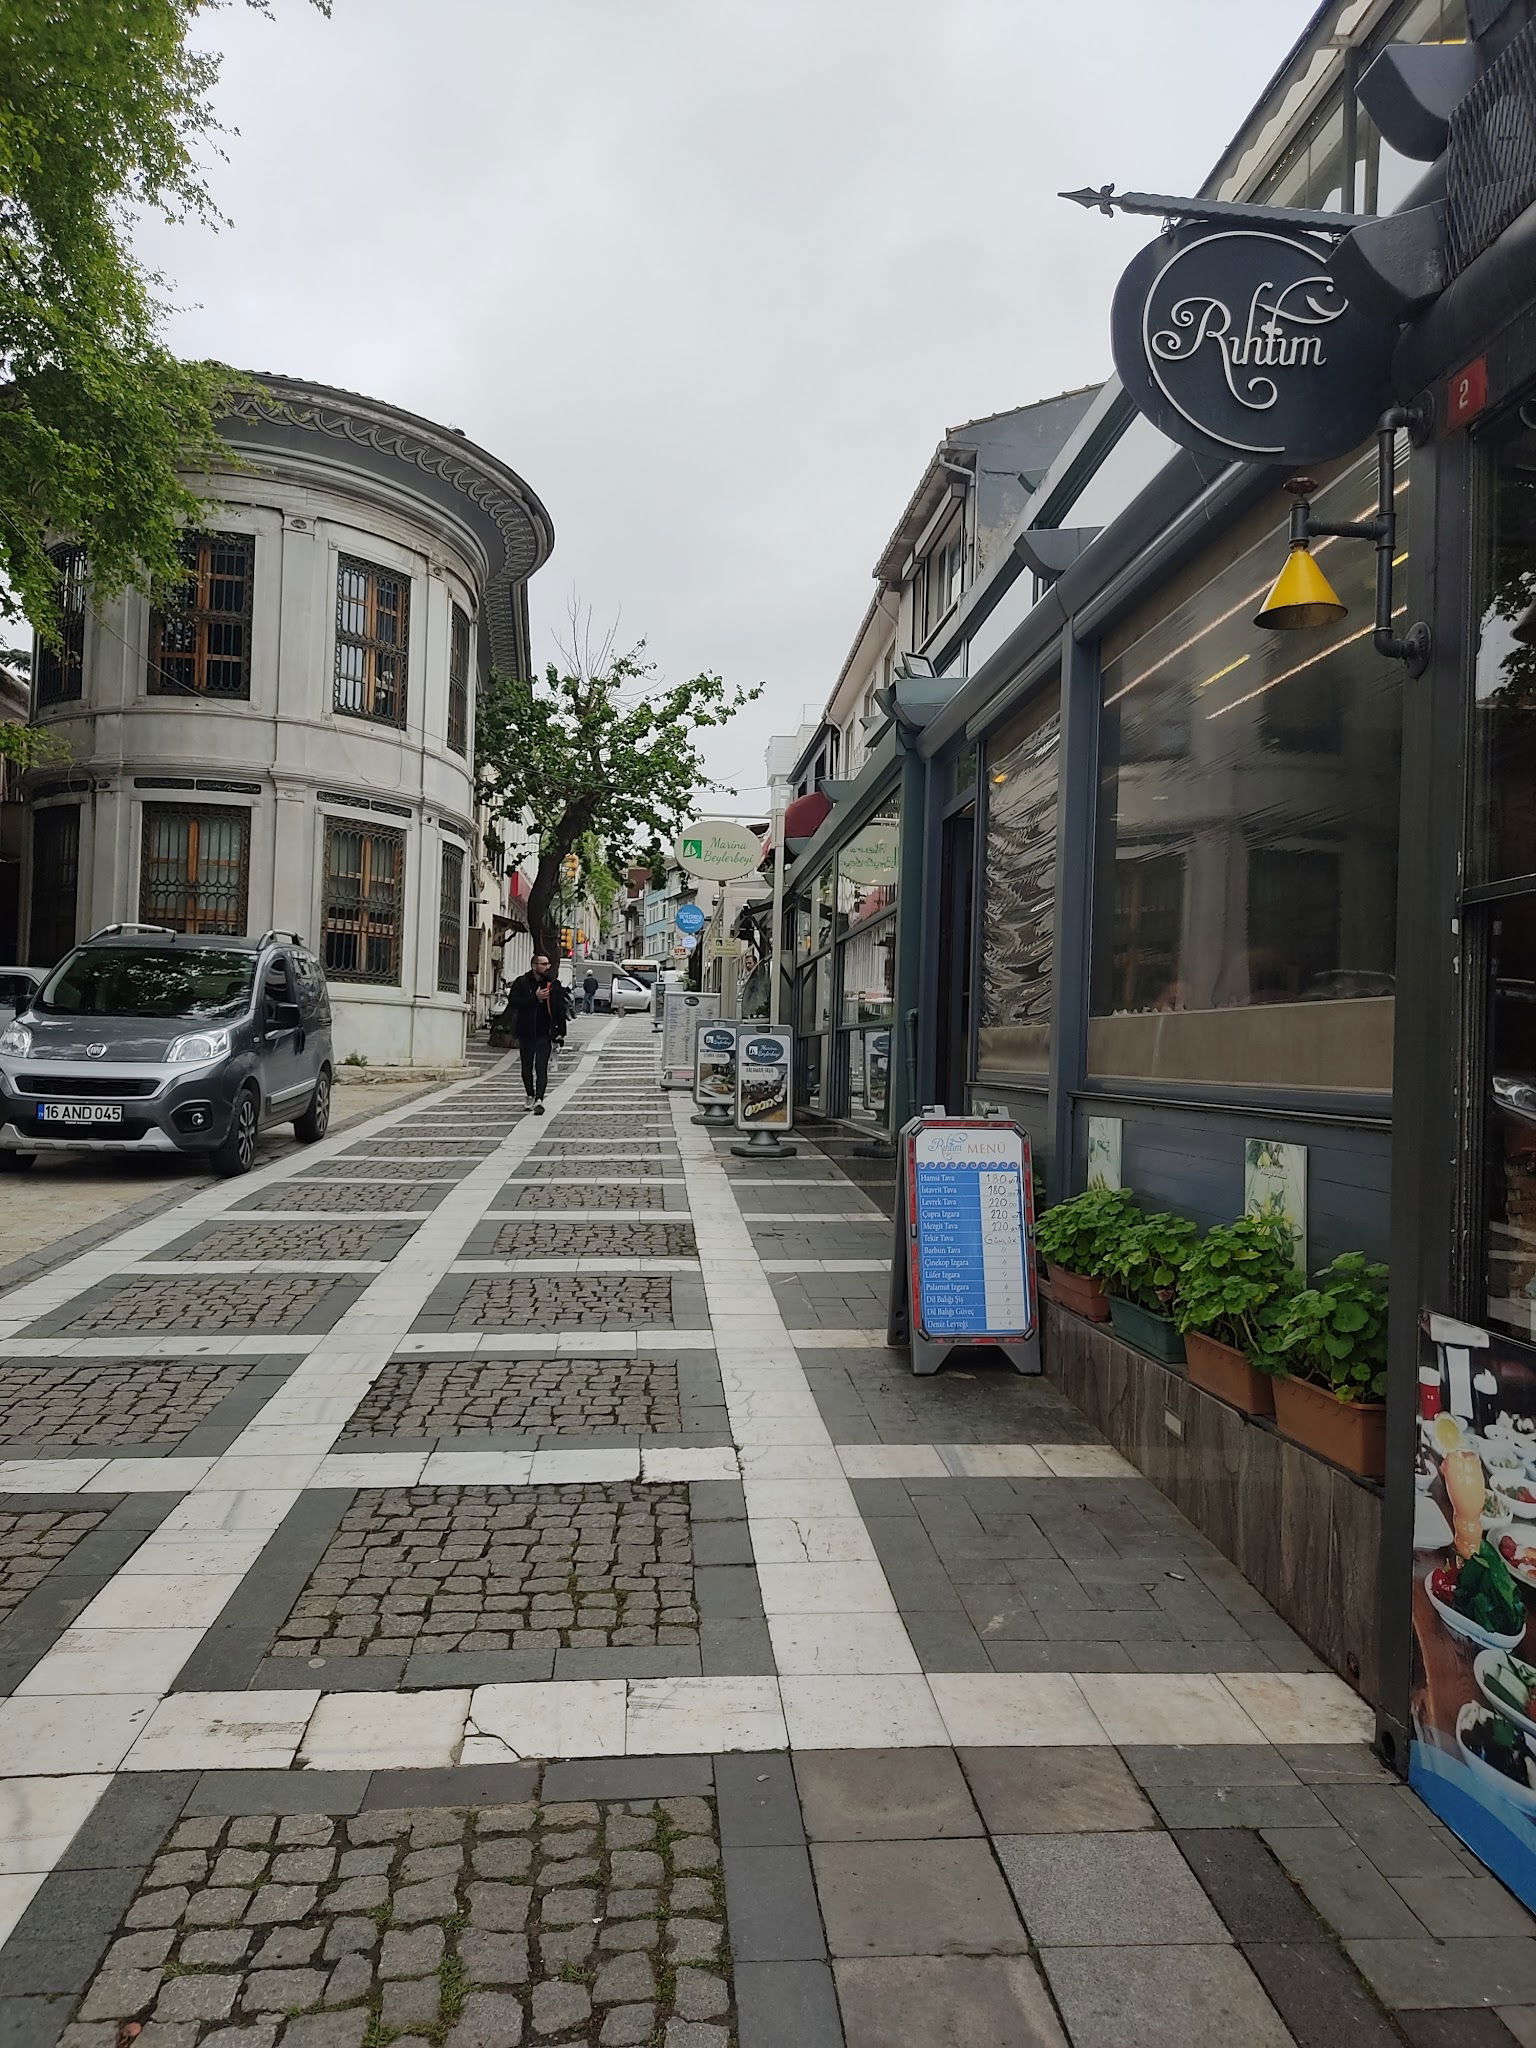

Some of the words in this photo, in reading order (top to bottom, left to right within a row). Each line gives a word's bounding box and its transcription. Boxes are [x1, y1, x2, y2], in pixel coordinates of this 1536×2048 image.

[1459, 379, 1469, 409] 2
[710, 837, 746, 850] Marina
[703, 851, 754, 866] Beylerbeyi
[46, 1105, 59, 1119] 16
[62, 1106, 92, 1119] AND
[95, 1107, 121, 1120] 045
[921, 1174, 939, 1182] Hamsi
[941, 1174, 955, 1182] Tava
[943, 1186, 957, 1194] Tava
[988, 1185, 1007, 1196] 180
[922, 1198, 941, 1206] Levrek
[943, 1198, 957, 1206] Tava
[989, 1198, 1008, 1208] 220
[990, 1209, 1008, 1219] 220
[923, 1221, 943, 1231] Mezgit
[944, 1221, 958, 1229] Tava
[991, 1221, 1009, 1231] 220
[924, 1234, 939, 1242] Tekir
[939, 1234, 954, 1242] Tava
[924, 1246, 946, 1254] Barbun
[946, 1246, 961, 1254] Tava
[925, 1271, 941, 1279] Lüfer
[926, 1283, 950, 1291] Palamut
[926, 1295, 935, 1303] Dil
[937, 1295, 953, 1304] Balığı
[937, 1308, 955, 1317] Balığı
[955, 1308, 975, 1317] Güveç
[927, 1320, 945, 1328] Deniz
